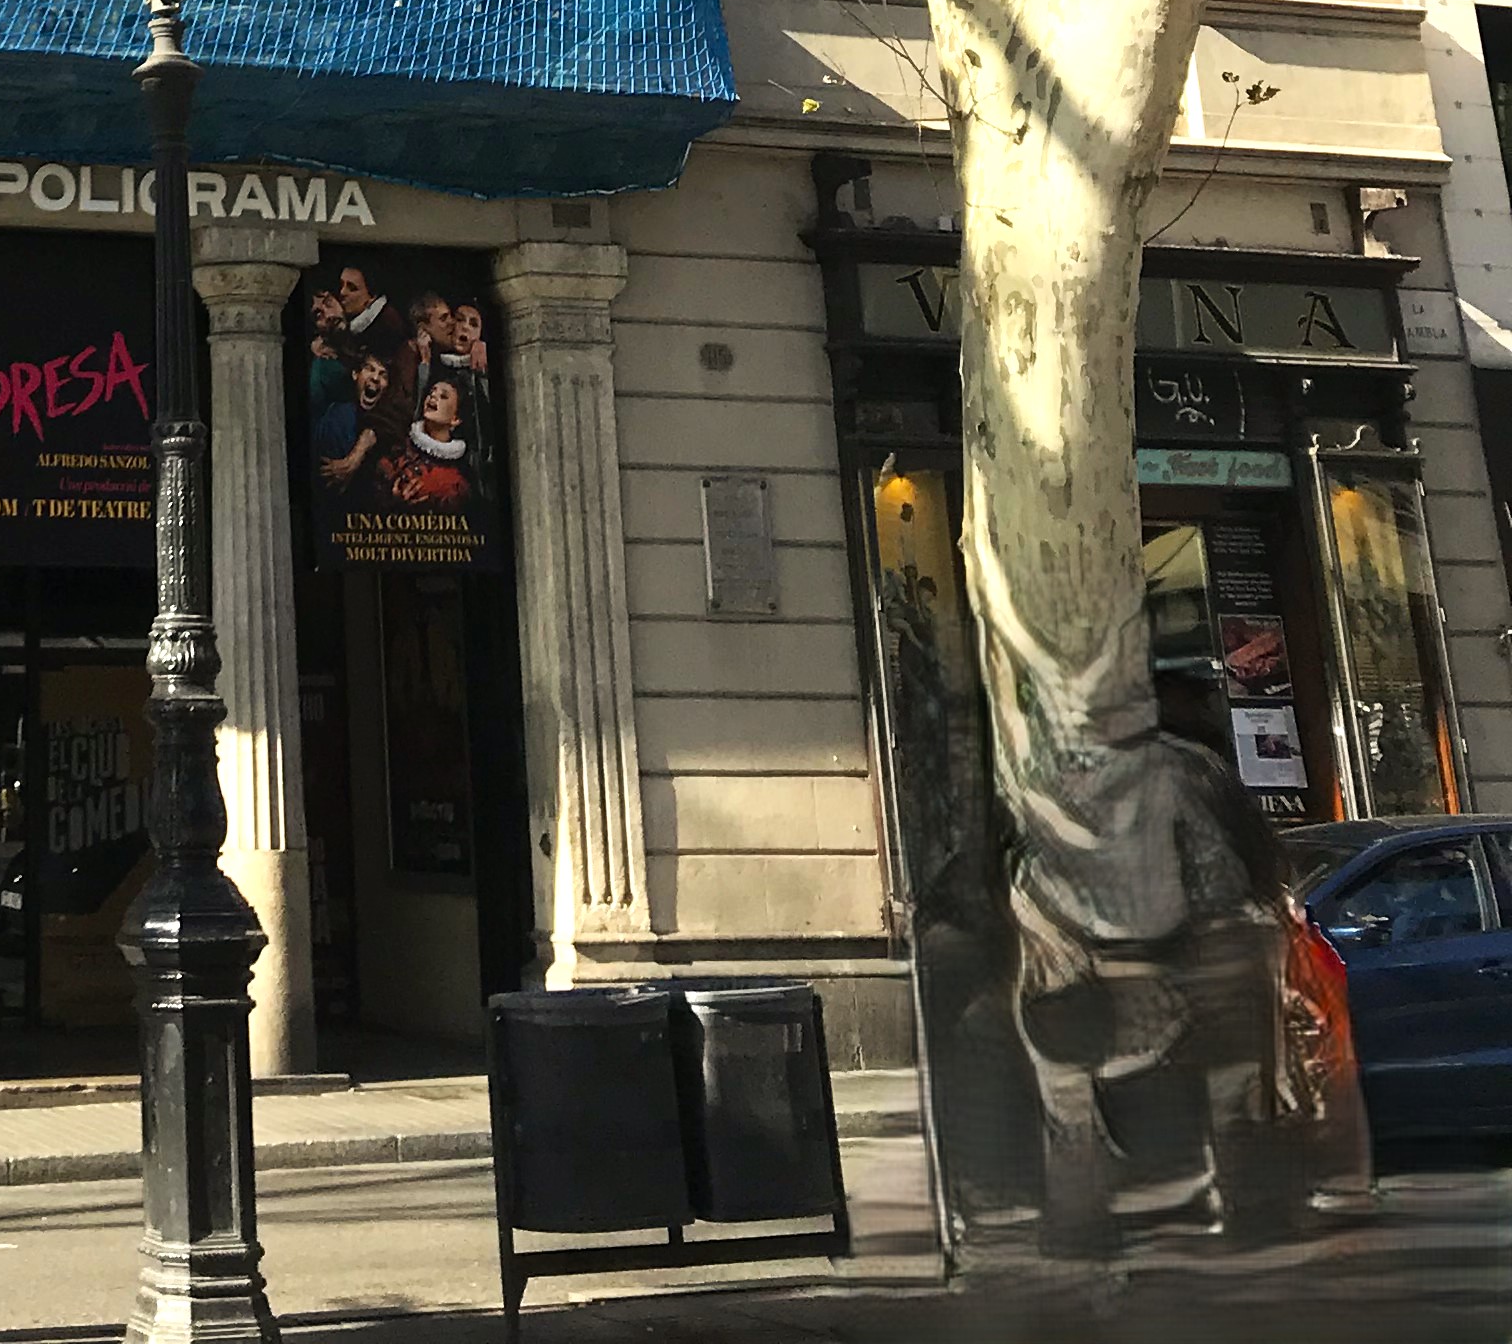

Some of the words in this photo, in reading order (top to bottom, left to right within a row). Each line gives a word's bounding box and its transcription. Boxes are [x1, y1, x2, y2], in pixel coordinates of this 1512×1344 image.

[895, 266, 1356, 349] VNA
[36, 453, 98, 468] ALFREDO
[99, 455, 152, 470] SANZOL
[47, 499, 75, 518] DE
[77, 499, 152, 519] TEATRE
[346, 512, 384, 530] UNA
[346, 546, 388, 561] MOLT
[391, 547, 472, 562] DIVERTIDA
[1257, 794, 1306, 812] IENA
